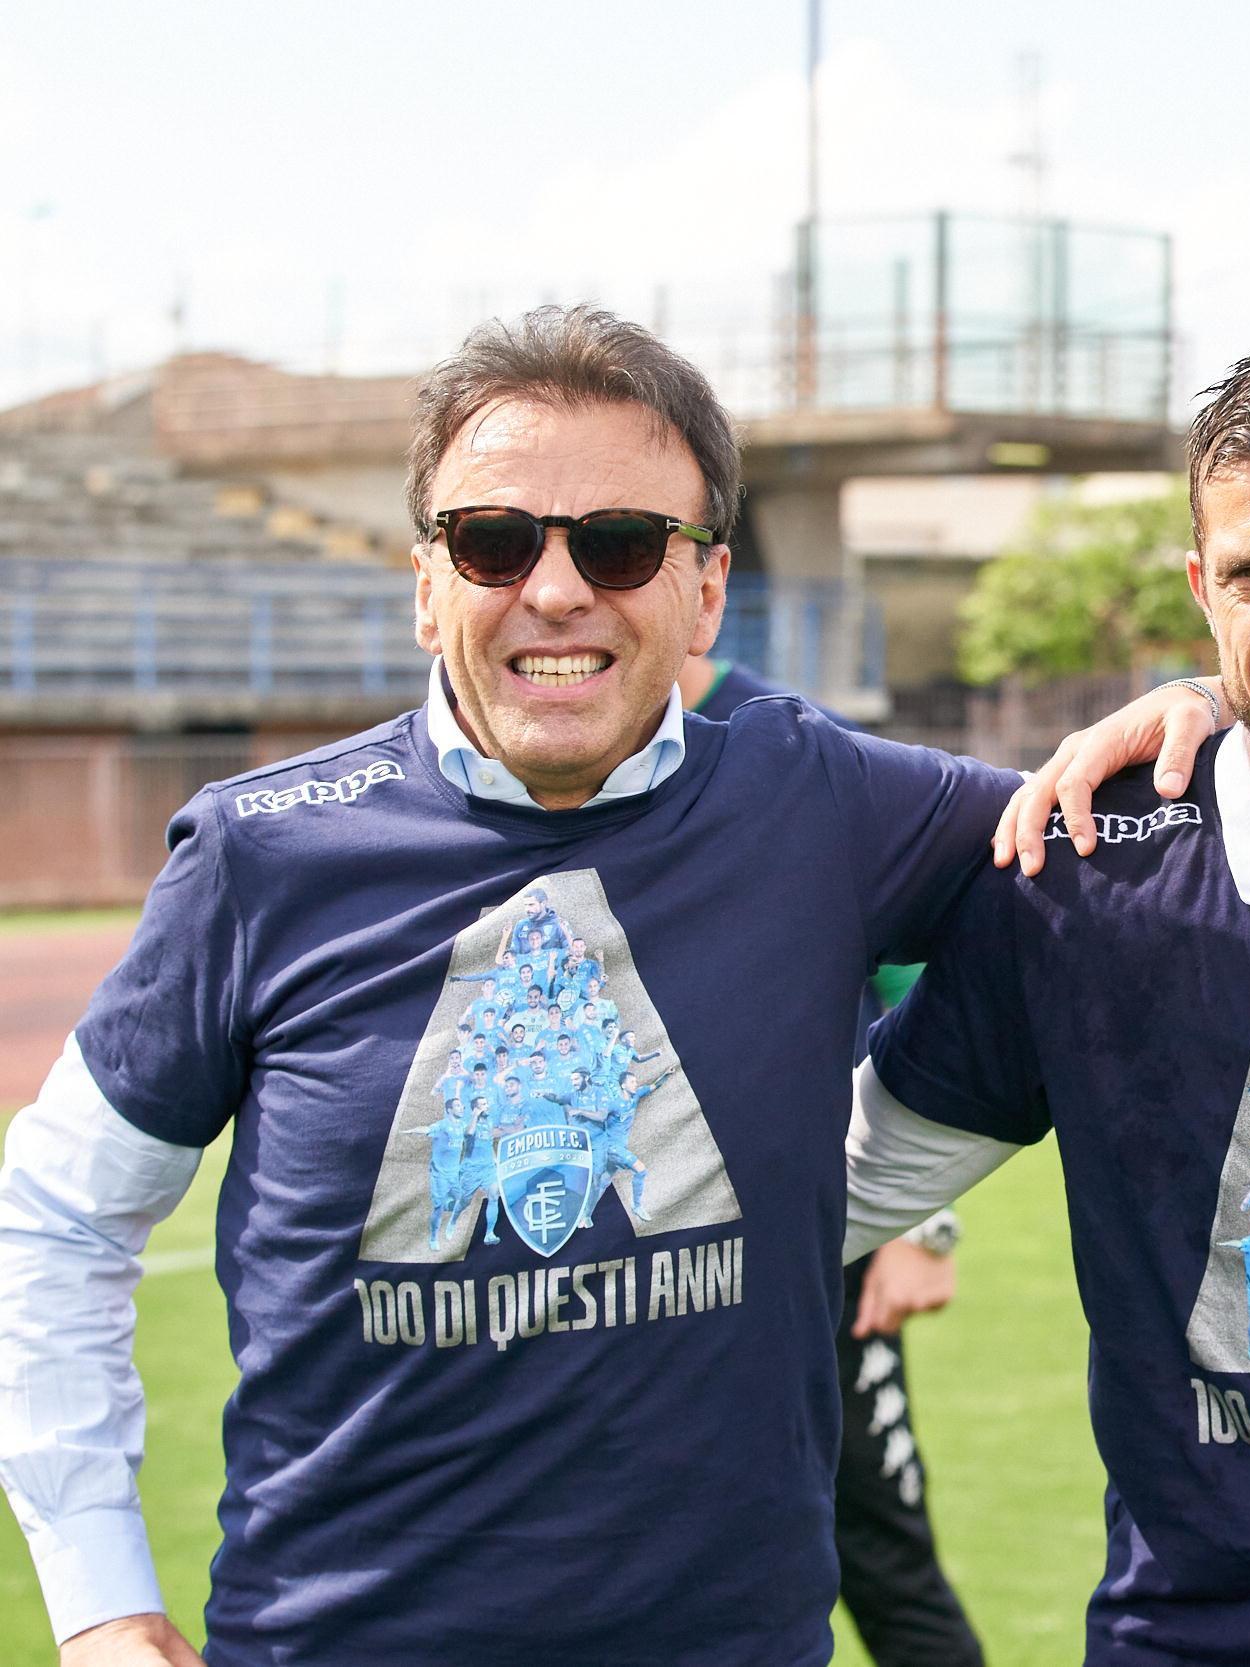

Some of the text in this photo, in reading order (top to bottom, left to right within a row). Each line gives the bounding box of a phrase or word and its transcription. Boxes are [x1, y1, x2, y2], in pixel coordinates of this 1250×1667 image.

[235, 760, 406, 818] Kappa
[507, 1130, 583, 1158] EMPOLI F.C.
[354, 1237, 744, 1352] 100 DI QUESTI ANNI
